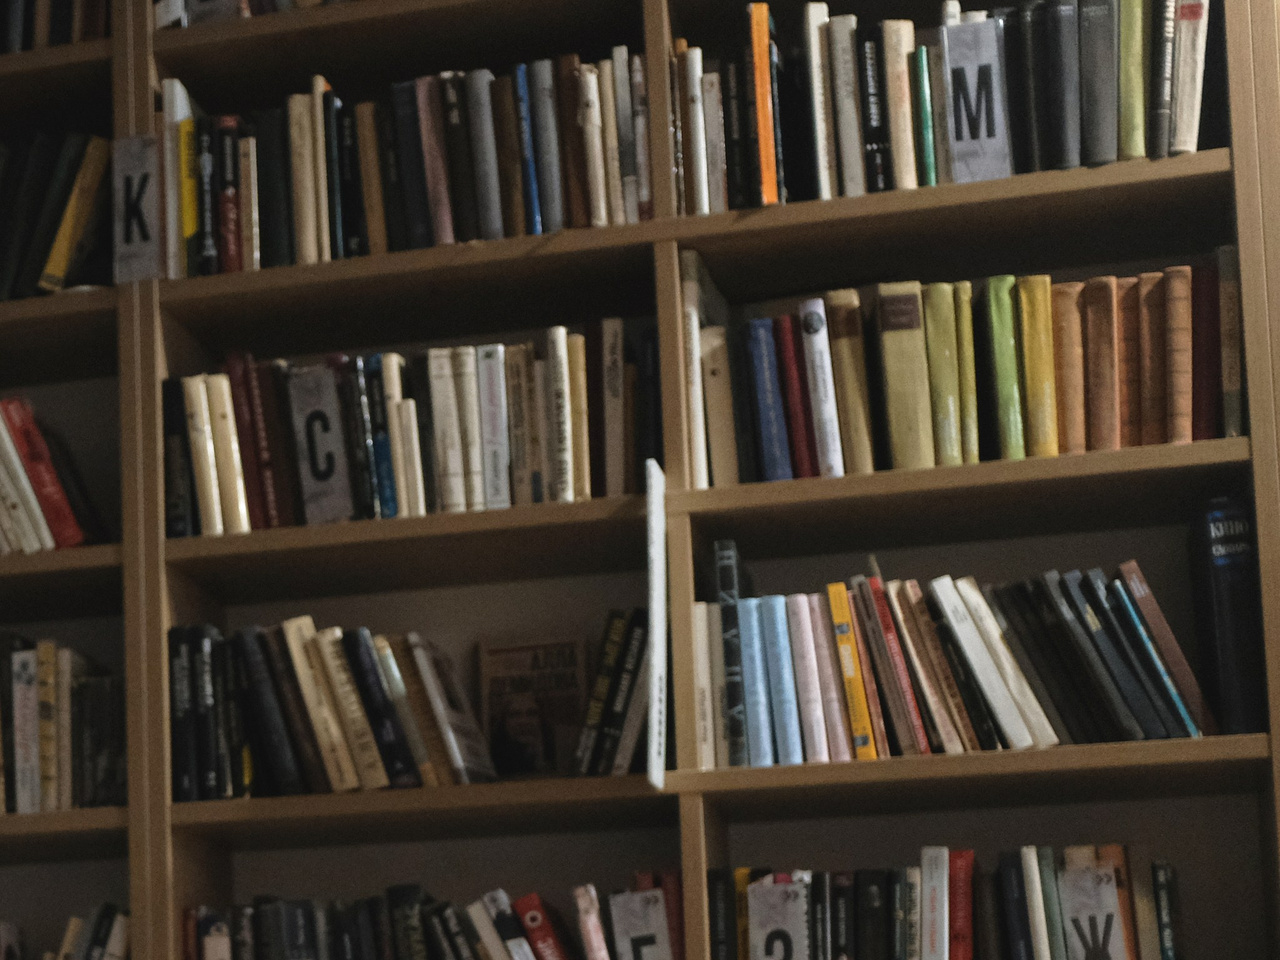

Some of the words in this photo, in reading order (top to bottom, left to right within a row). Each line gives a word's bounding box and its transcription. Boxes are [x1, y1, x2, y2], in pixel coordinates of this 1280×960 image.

[951, 64, 996, 141] М
[123, 172, 150, 245] К
[305, 409, 335, 481] С
